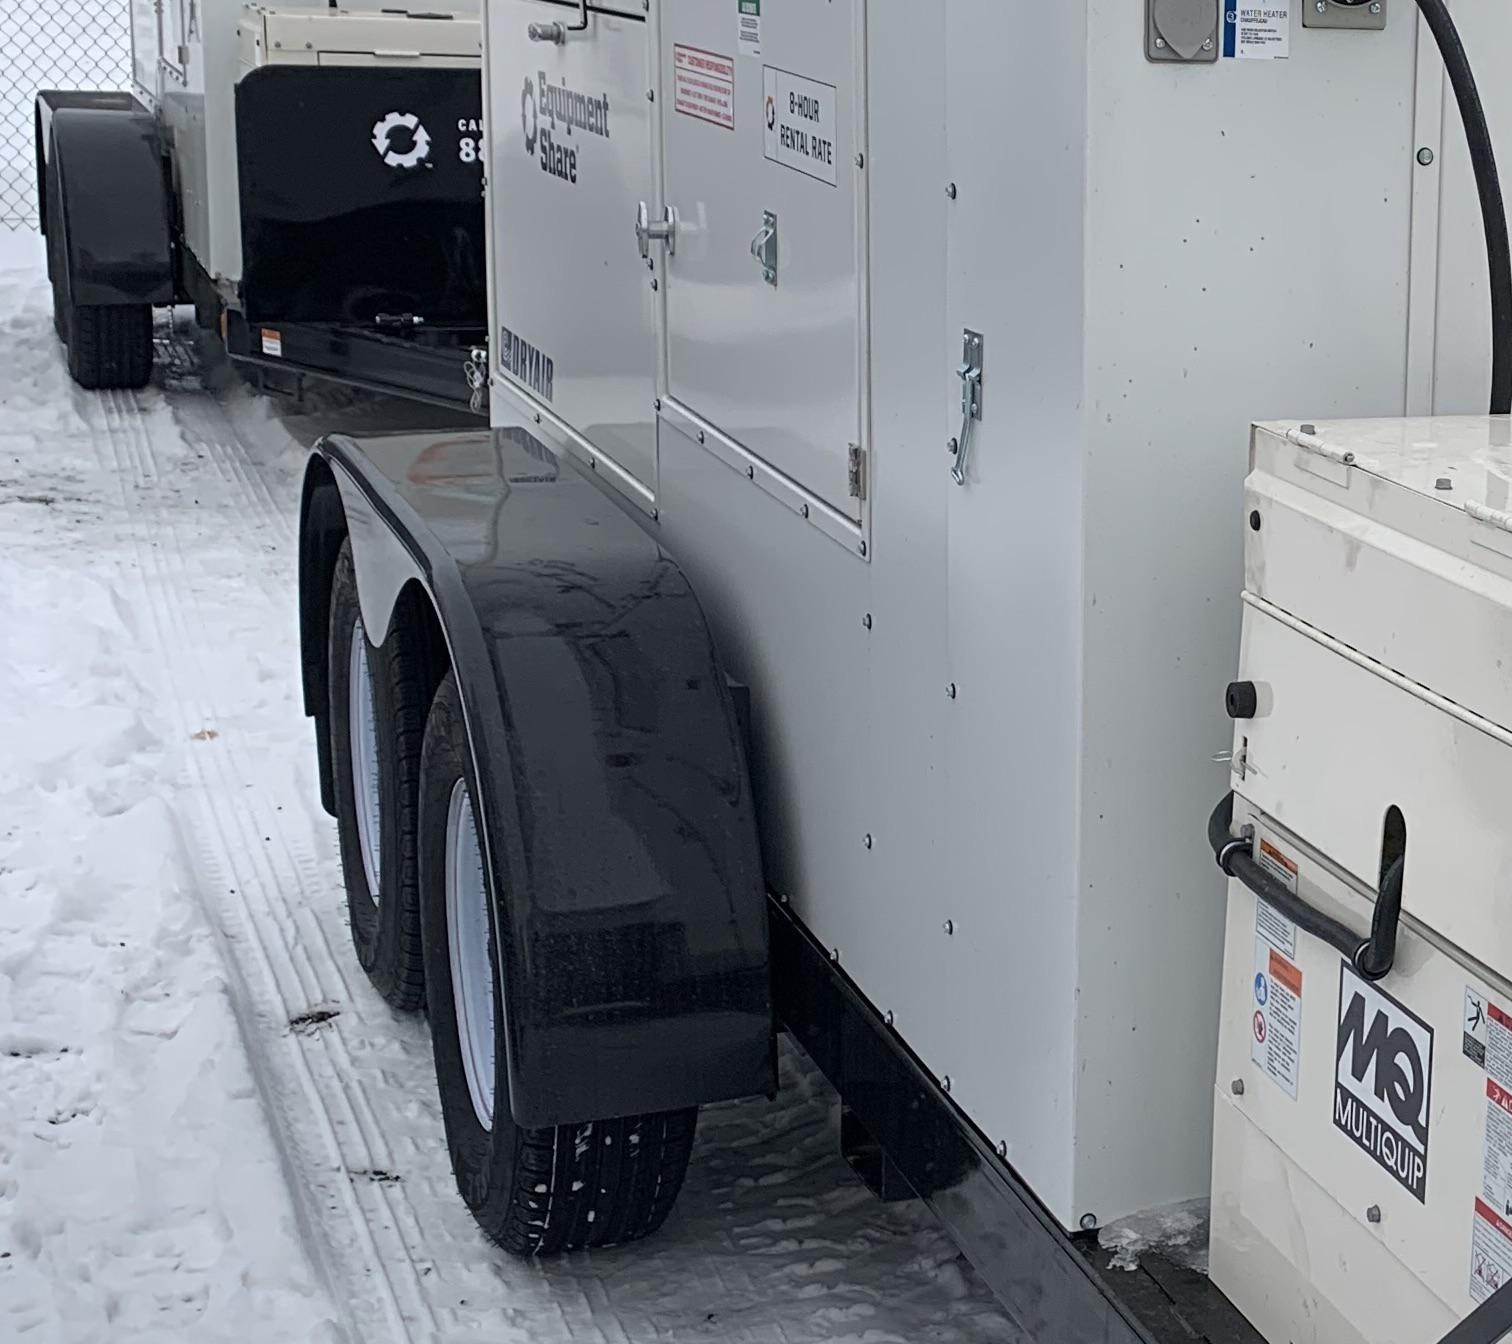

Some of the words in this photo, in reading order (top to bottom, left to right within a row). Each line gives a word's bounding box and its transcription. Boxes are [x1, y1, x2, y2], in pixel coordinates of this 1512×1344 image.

[1240, 9, 1262, 18] WATER
[1262, 10, 1288, 19] HEATER
[538, 70, 610, 139] Equipment
[789, 91, 820, 123] 8-HOUR
[540, 127, 577, 184] Share
[780, 123, 810, 157] RENTAL
[811, 135, 833, 166] RATE
[512, 332, 554, 404] DRYAIR
[1335, 1087, 1424, 1190] MULTIQUIP
